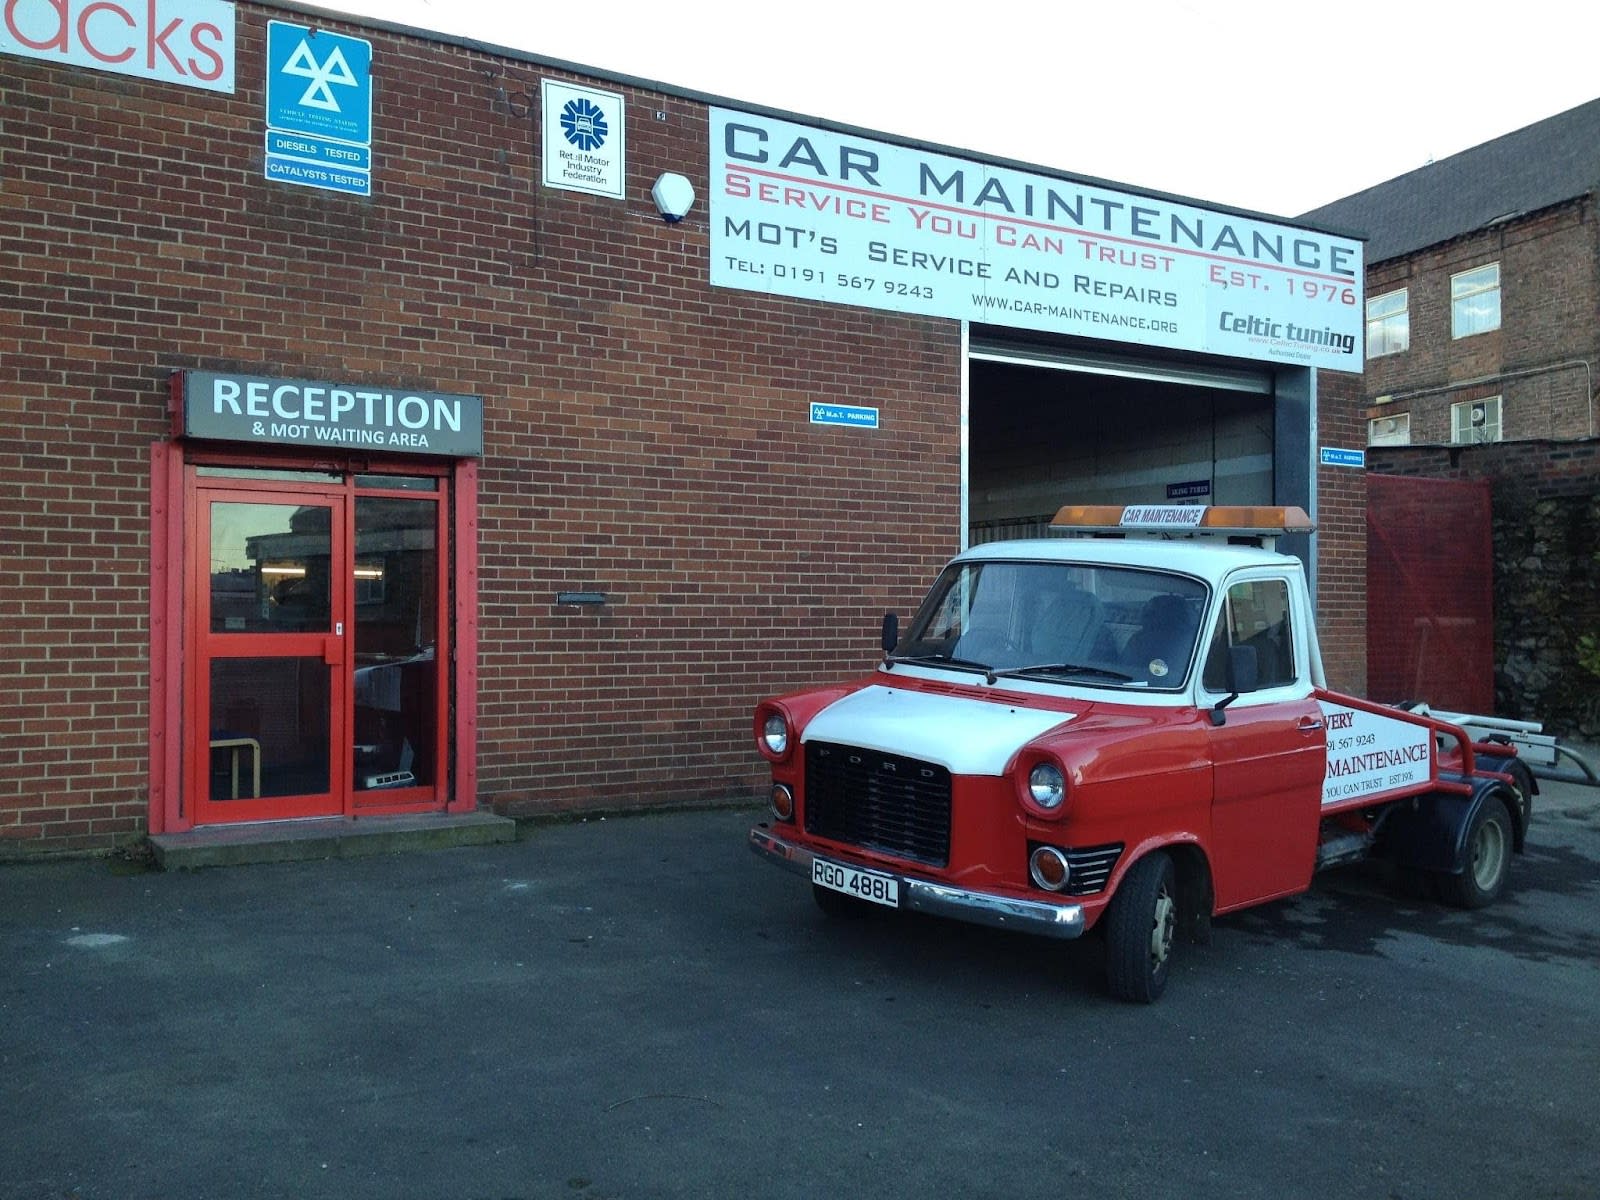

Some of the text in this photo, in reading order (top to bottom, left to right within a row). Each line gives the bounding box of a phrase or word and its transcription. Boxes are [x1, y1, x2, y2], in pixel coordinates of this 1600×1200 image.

[276, 139, 361, 162] DIESELS TESTED
[584, 154, 610, 167] Motor
[270, 163, 366, 188] CATALYSTS TESTED
[563, 169, 607, 185] Federation
[567, 160, 602, 176] Industry
[725, 122, 1355, 277] CAR MAINTENANCE
[725, 173, 1356, 305] SERVICE YOU CAN TRUST EST. 1976
[725, 216, 1177, 307] MOT'S SERVICE AND REPAIRS
[725, 256, 934, 299] TEL: 0191 567 9243
[972, 293, 1178, 334] WWW.CAR-MAINTENANCE.ORG
[1220, 311, 1355, 354] Celtic tuning
[213, 379, 461, 432] RECEPTION
[847, 413, 875, 421] PARKING
[252, 421, 428, 448] & MOT WAITING AREA
[1124, 509, 1201, 523] CAR MAINTENANCE
[1338, 737, 1353, 750] 567
[1356, 733, 1376, 747] 9243
[820, 749, 934, 778] FORD
[1328, 743, 1428, 779] MAINTENANCE
[1326, 785, 1342, 799] YOU
[1343, 782, 1360, 795] CAN
[1360, 777, 1384, 791] TRUST
[814, 862, 897, 904] RGO 488L
